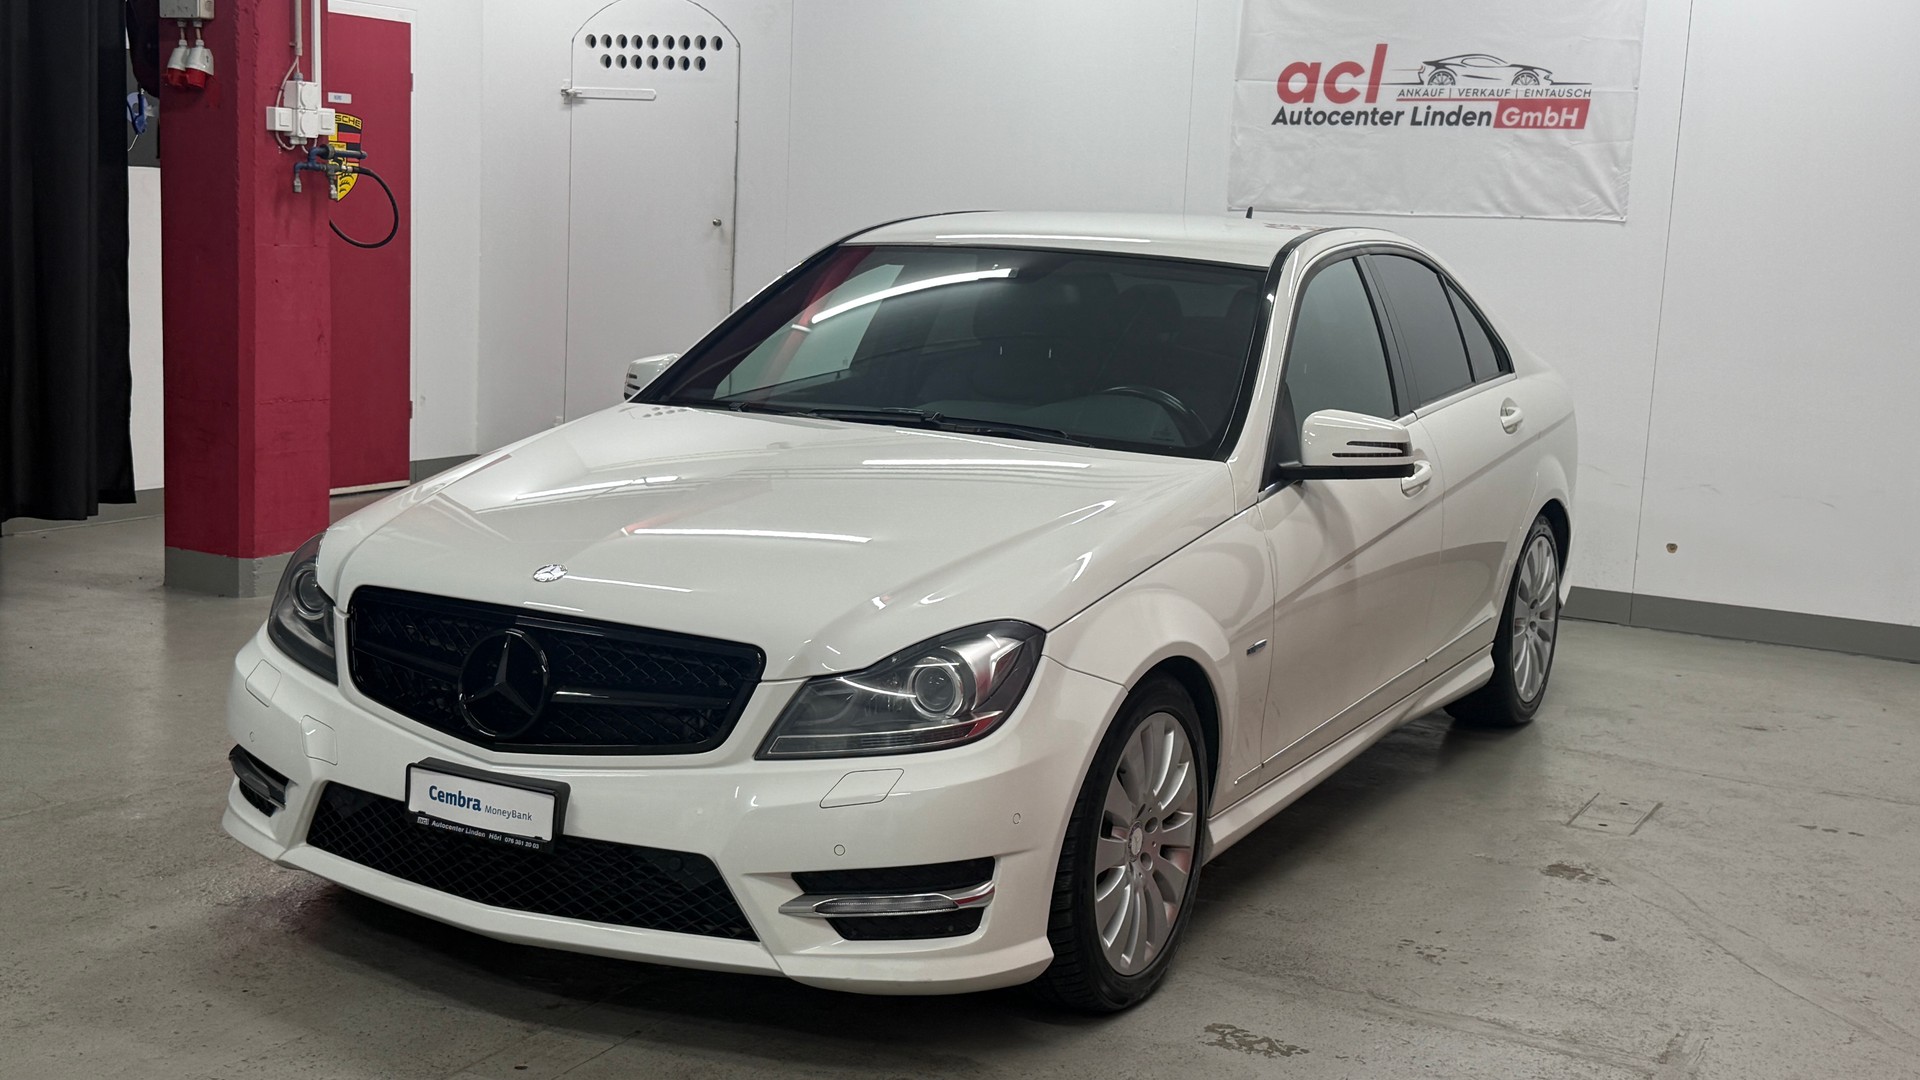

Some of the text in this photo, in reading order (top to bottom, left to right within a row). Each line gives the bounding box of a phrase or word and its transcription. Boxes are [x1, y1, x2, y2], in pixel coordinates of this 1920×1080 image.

[1277, 43, 1388, 104] acl
[1397, 88, 1592, 98] ANKAUF VERKAUF EINTAUSCH
[1271, 105, 1579, 127] Autocenter Linden GmbH
[429, 785, 533, 821] Cembra MoneyBank
[432, 820, 464, 832] Autocenter
[466, 828, 486, 837] Linden
